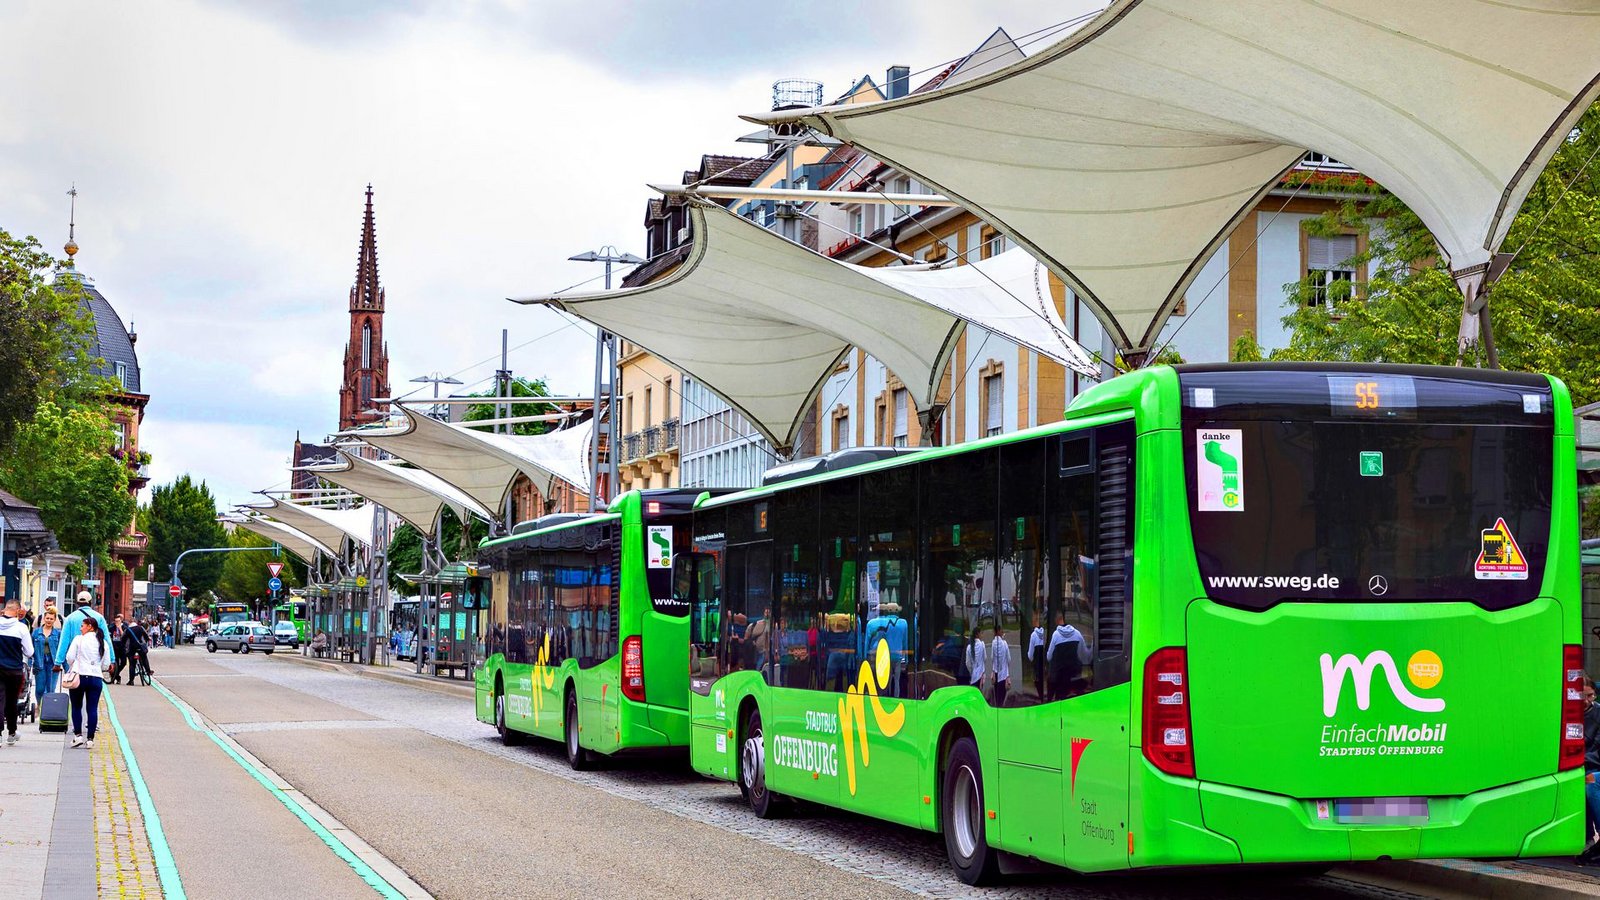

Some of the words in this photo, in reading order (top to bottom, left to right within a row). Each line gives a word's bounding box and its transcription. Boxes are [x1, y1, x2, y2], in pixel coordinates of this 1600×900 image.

[1355, 382, 1379, 409] S5
[1202, 432, 1231, 441] danke
[1208, 573, 1340, 592] www.sweg.de
[805, 710, 837, 734] STADTBUS
[1320, 723, 1448, 743] EinfachMobil
[773, 734, 838, 777] OFFENBURG
[1081, 798, 1097, 816] Stadt
[1082, 820, 1115, 846] Offenburg
